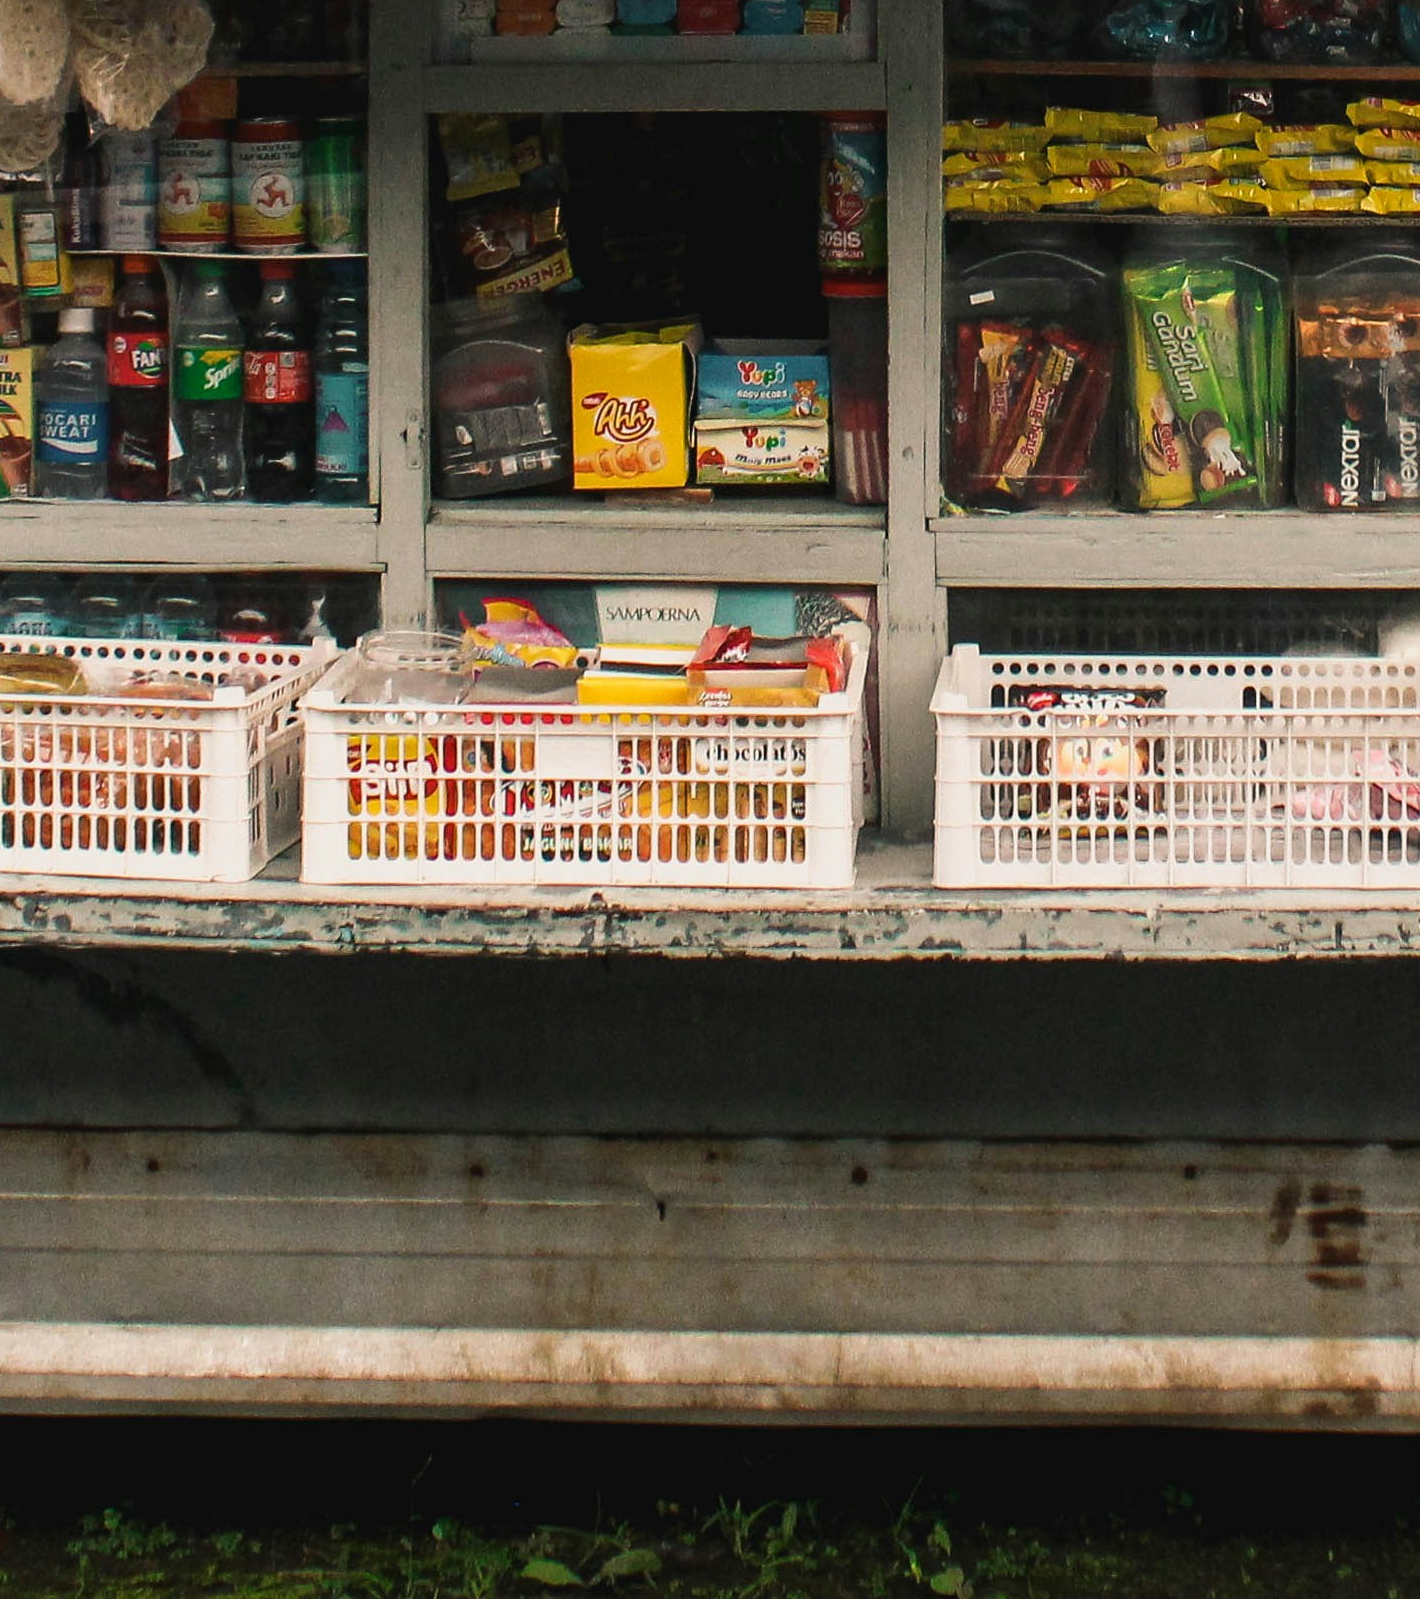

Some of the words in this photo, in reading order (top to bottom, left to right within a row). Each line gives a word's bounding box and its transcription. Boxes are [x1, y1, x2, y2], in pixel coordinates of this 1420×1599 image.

[482, 259, 567, 297] ENERGE
[1150, 311, 1201, 403] Gandum
[1175, 323, 1208, 373] Sari
[737, 360, 786, 387] Yupi
[742, 426, 787, 452] Yupi
[606, 606, 701, 622] SAMPOERNA
